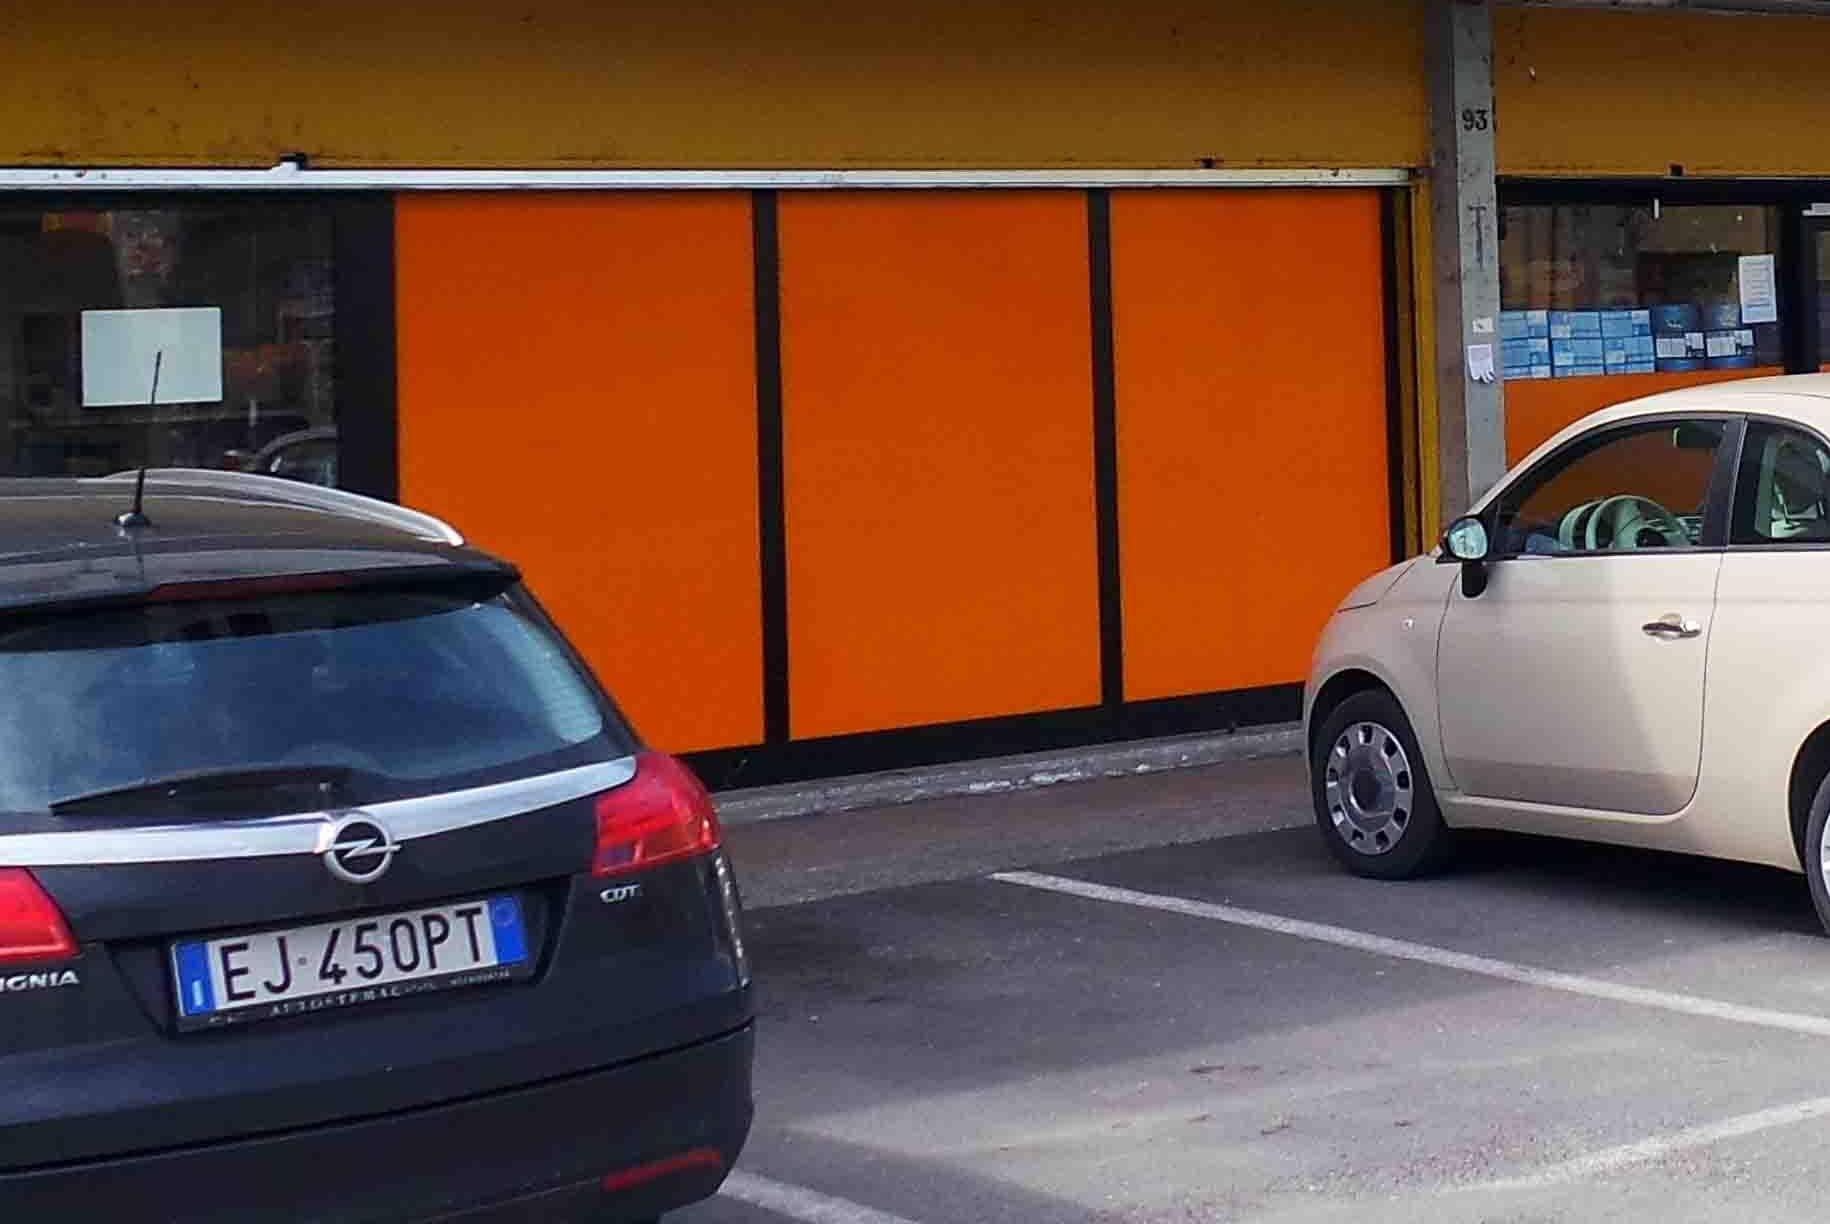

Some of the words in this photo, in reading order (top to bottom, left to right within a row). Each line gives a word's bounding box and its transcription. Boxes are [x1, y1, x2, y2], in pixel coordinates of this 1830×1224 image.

[1462, 108, 1488, 131] 93
[219, 935, 292, 1002] EJ
[317, 906, 483, 986] 450PT
